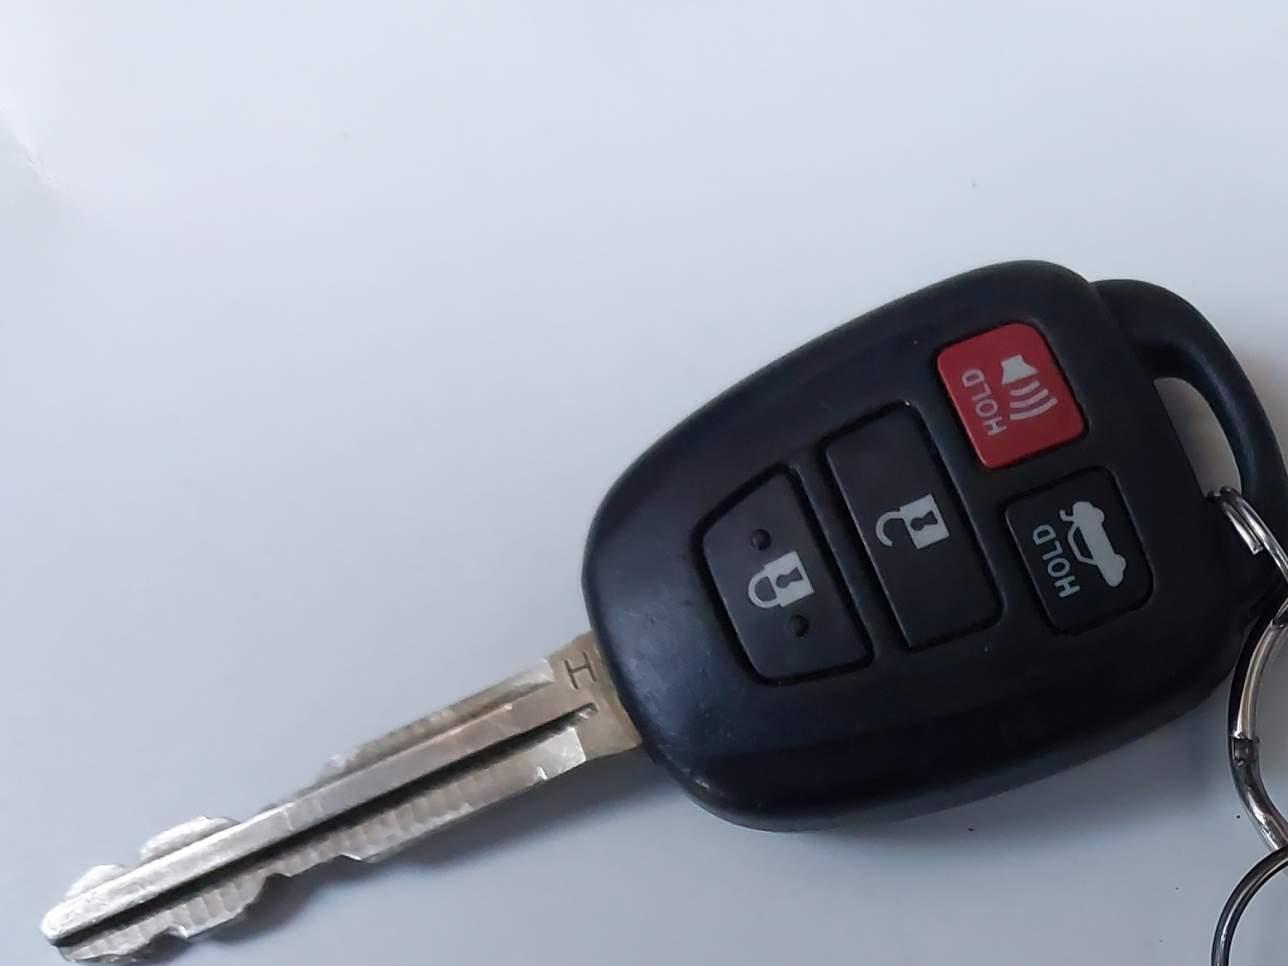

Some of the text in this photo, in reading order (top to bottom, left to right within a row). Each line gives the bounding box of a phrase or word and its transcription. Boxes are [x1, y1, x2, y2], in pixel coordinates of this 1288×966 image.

[960, 368, 1007, 436] HOLD
[1031, 523, 1081, 598] HOLD
[564, 651, 598, 690] H
